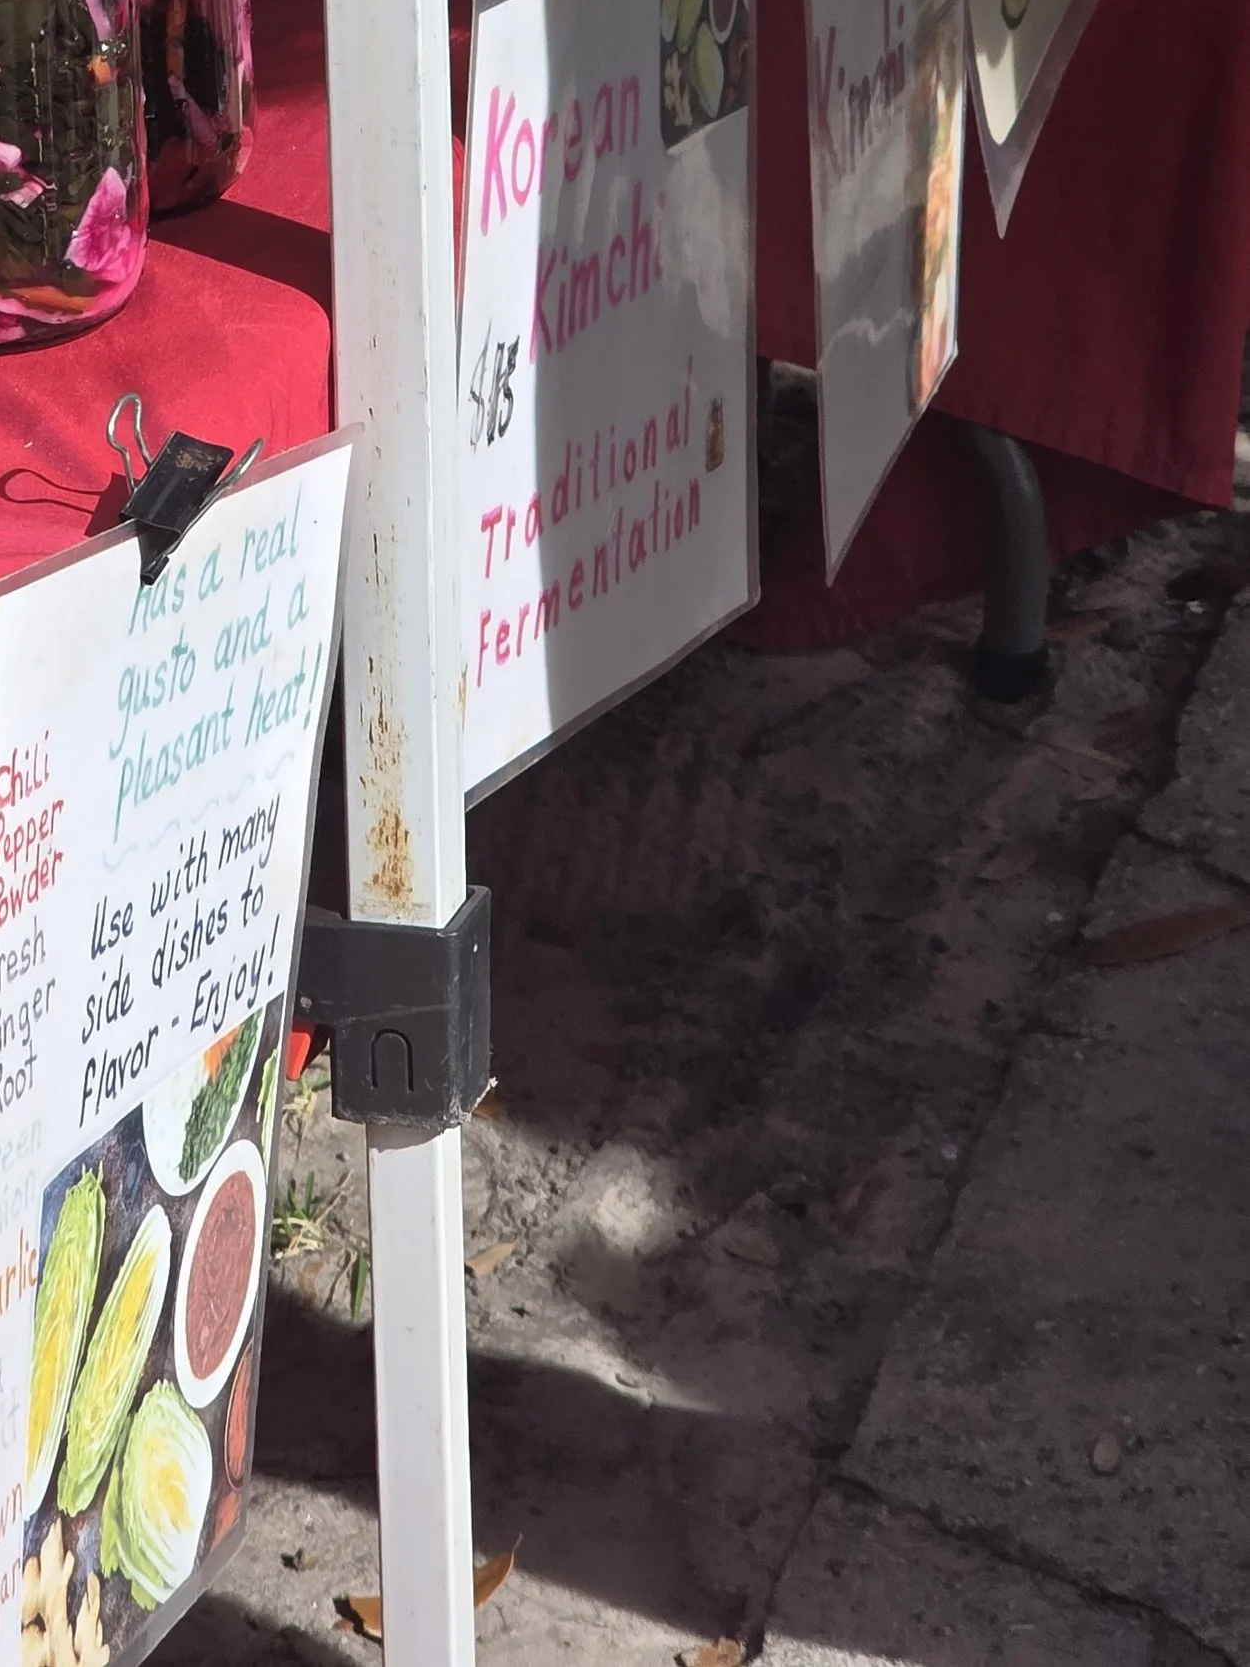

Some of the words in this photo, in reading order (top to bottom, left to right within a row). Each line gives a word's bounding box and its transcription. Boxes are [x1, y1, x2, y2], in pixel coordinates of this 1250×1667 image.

[480, 74, 641, 237] Korean
[529, 180, 667, 366] Kimchi
[481, 354, 694, 579] Traditional
[128, 562, 187, 635] has
[198, 542, 224, 602] a
[240, 482, 304, 581] real
[109, 622, 197, 759] gusto
[213, 584, 272, 672] and
[287, 572, 310, 630] a
[244, 637, 323, 747] heat!
[81, 953, 135, 1045] side
[151, 897, 228, 989] dishes
[240, 865, 265, 929] to
[90, 895, 134, 961] Use
[150, 830, 208, 918] with
[218, 792, 281, 869] many
[190, 914, 281, 1035] Enjoy!
